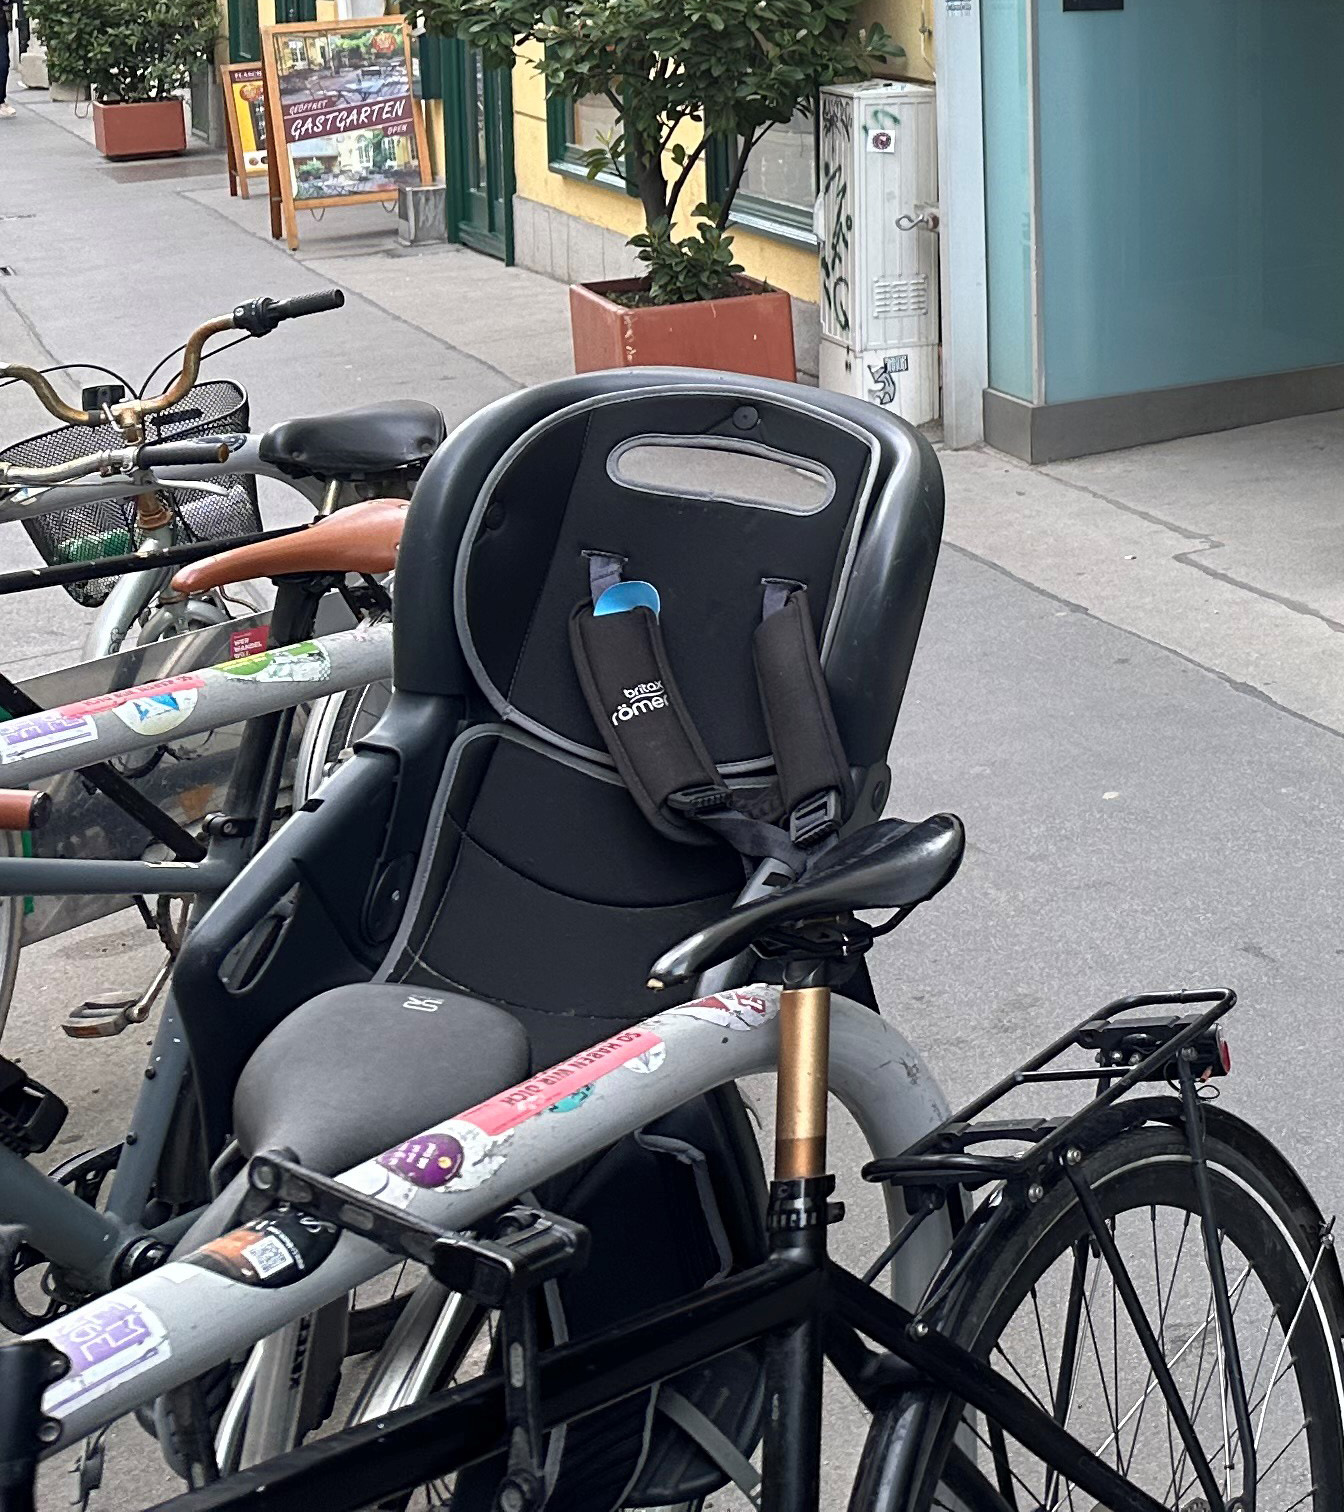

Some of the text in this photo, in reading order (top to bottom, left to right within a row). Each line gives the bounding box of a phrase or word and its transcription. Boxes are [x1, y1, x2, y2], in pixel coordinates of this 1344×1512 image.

[291, 99, 406, 141] GASTGARTEN
[387, 124, 408, 135] OPEN
[623, 680, 664, 698] britax
[612, 694, 668, 726] römer
